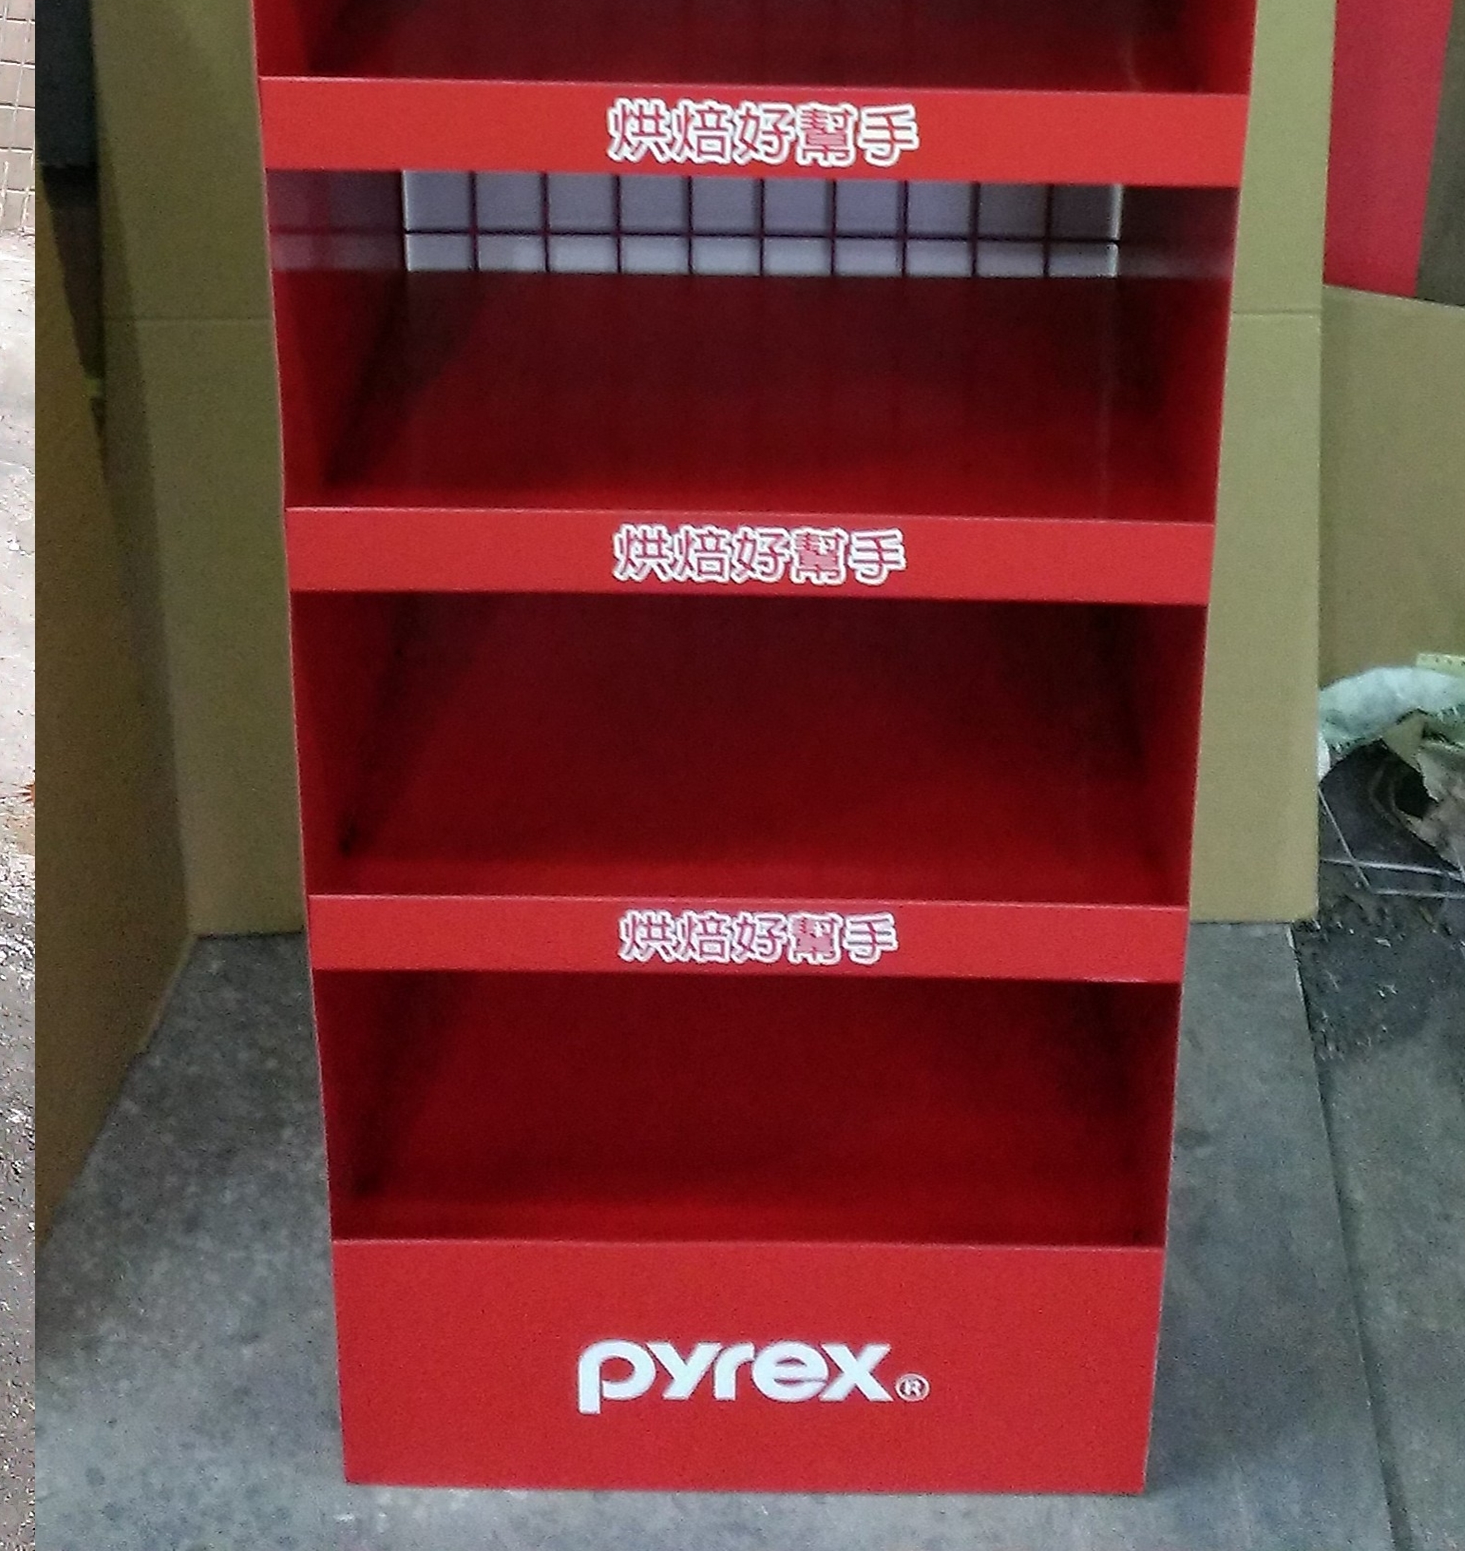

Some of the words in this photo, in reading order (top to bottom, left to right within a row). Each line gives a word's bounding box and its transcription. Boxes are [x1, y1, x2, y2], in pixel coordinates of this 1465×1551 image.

[605, 97, 920, 167] 烘焙好幫手
[612, 523, 907, 586] 烘焙好幫手
[617, 909, 899, 966] 烘焙好幫手
